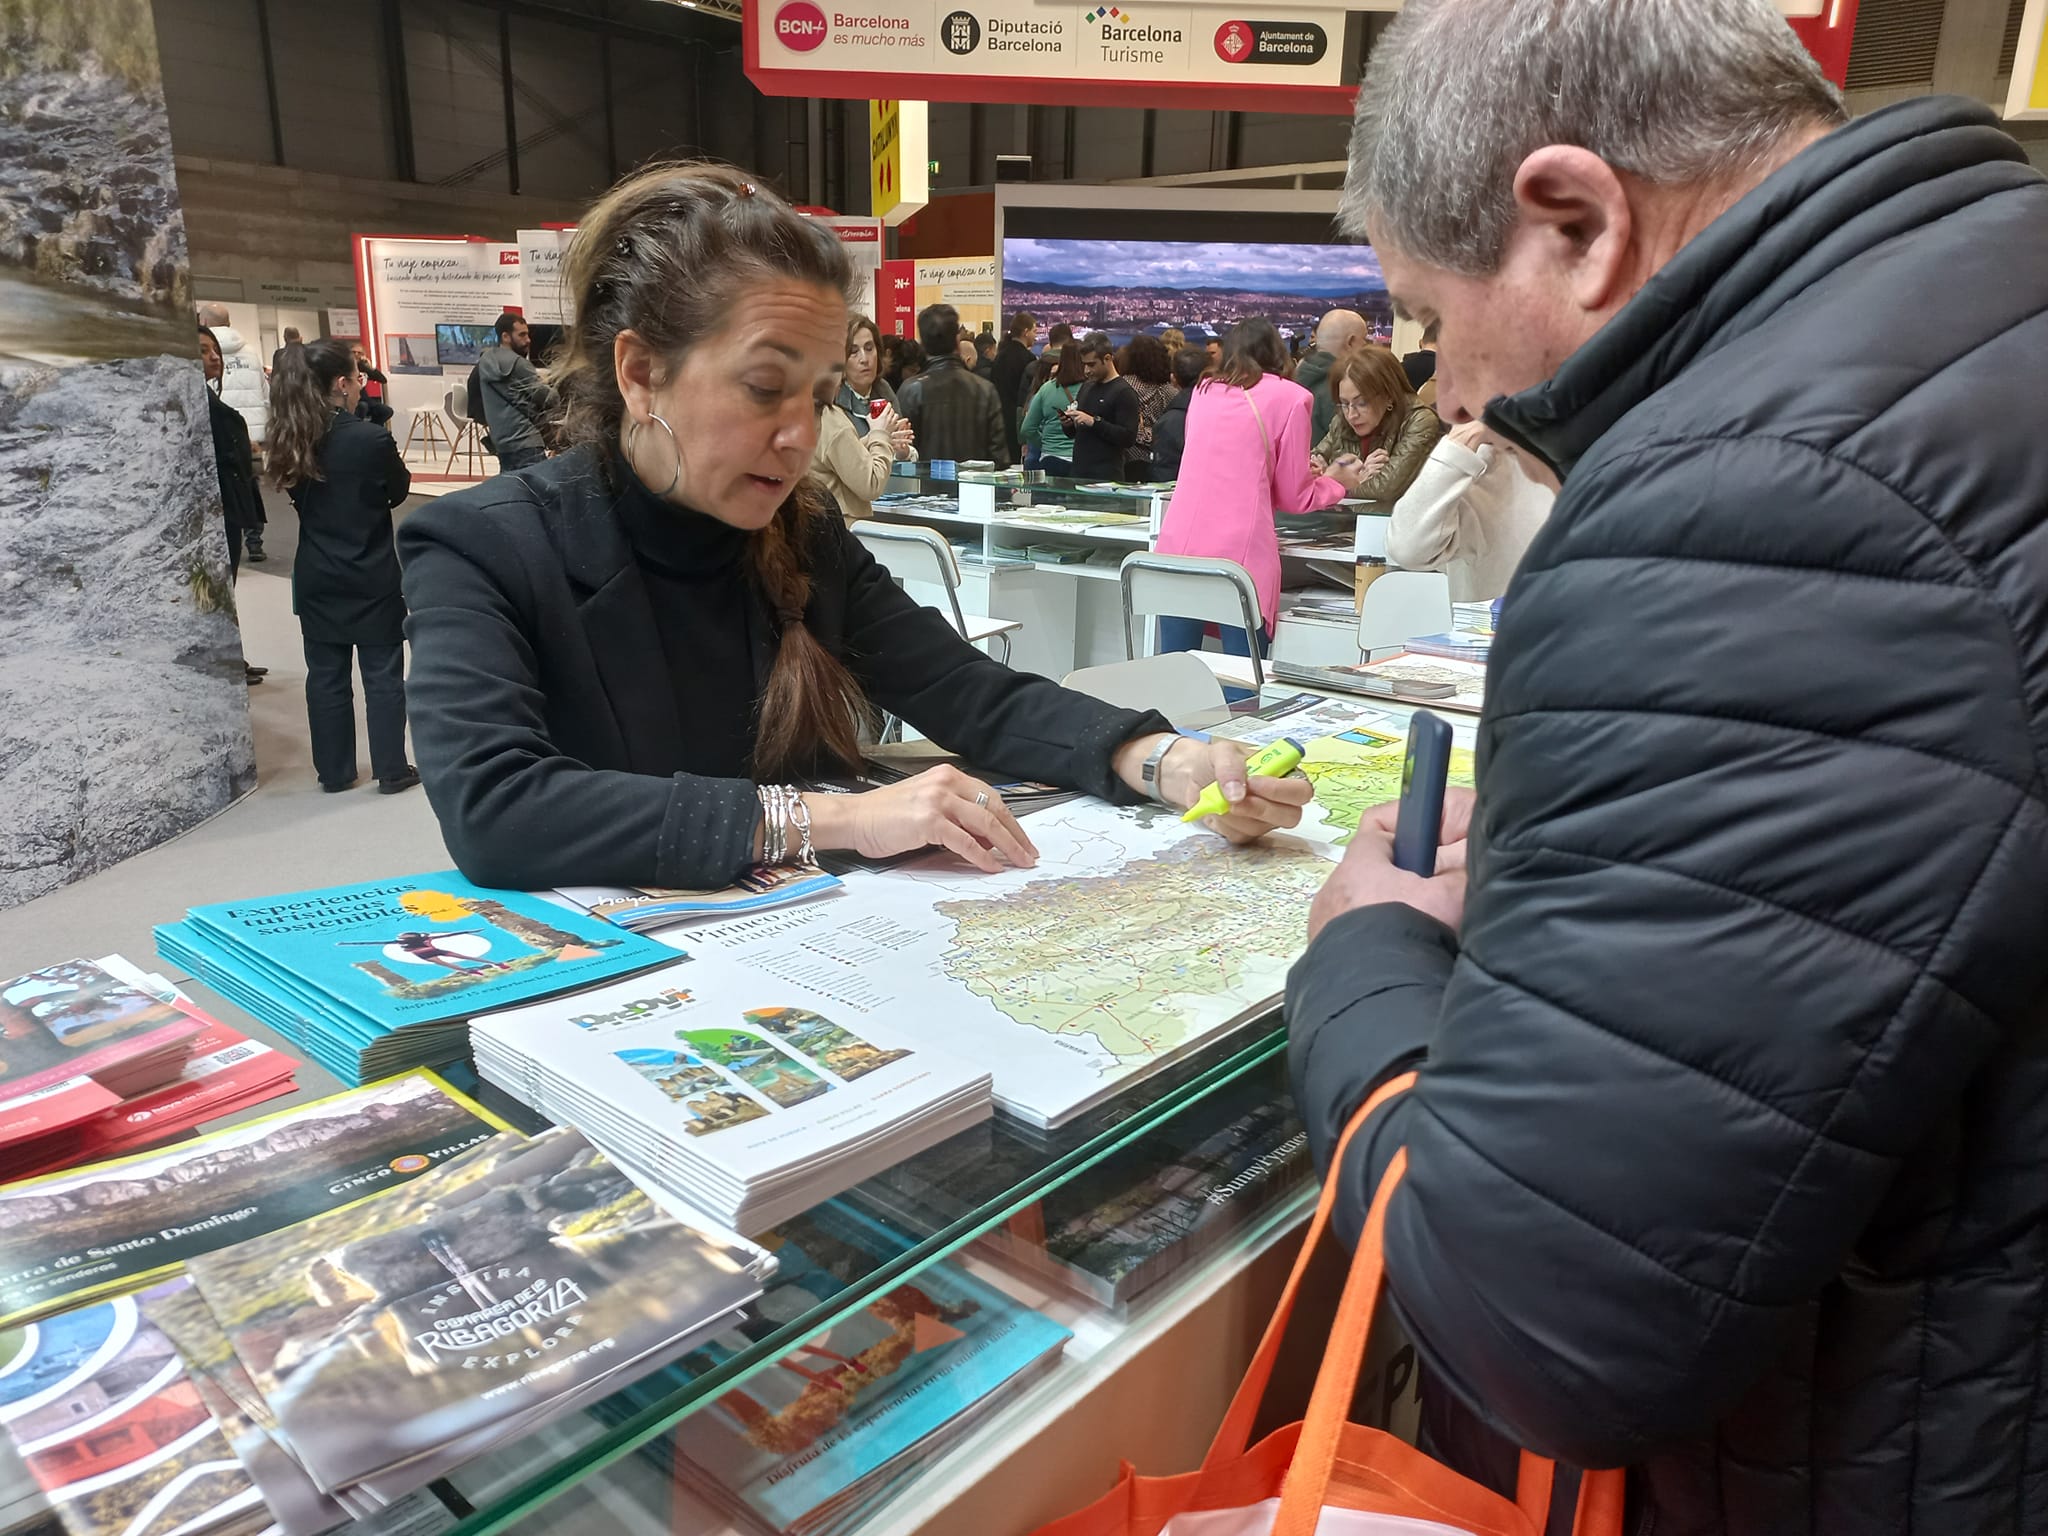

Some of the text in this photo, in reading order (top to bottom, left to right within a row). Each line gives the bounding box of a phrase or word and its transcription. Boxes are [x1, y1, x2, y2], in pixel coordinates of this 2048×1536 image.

[779, 18, 824, 35] BCN+
[833, 13, 910, 30] Barcelona
[988, 18, 1063, 37] Diputació
[833, 33, 925, 47] es mucho más
[1101, 24, 1183, 43] Barcelona
[1259, 31, 1315, 43] Ajuntament de
[987, 37, 1062, 54] Barcelona
[1101, 45, 1164, 64] Turisme
[1258, 41, 1314, 54] Barcelona
[384, 257, 459, 274] Tu viaje empieza
[530, 250, 540, 262] Tu
[920, 269, 928, 280] Tu
[929, 268, 945, 284] viaje
[947, 266, 977, 280] empieza
[978, 265, 986, 275] en
[225, 883, 417, 919] Experiencias
[257, 902, 420, 936] sostenibles
[683, 913, 781, 944] Pirineo
[721, 911, 830, 948] aragonés
[394, 998, 448, 1012] Disfruta
[450, 994, 465, 1002] de
[481, 974, 554, 995] experiencias
[328, 1167, 393, 1195] CINCO
[426, 1132, 491, 1159] VILLAS
[1205, 1131, 1309, 1206] #SunnyPyrenee
[53, 1253, 82, 1269] de
[86, 1235, 157, 1259] Santo
[158, 1206, 260, 1241] Domingo
[47, 1261, 118, 1286] senderos
[414, 1276, 589, 1364] RIBAGORZA
[461, 1314, 584, 1370] EXPLORA
[766, 1448, 822, 1486] Disfruta
[821, 1435, 840, 1453] de
[852, 1385, 925, 1433] experiencias
[924, 1374, 938, 1387] en
